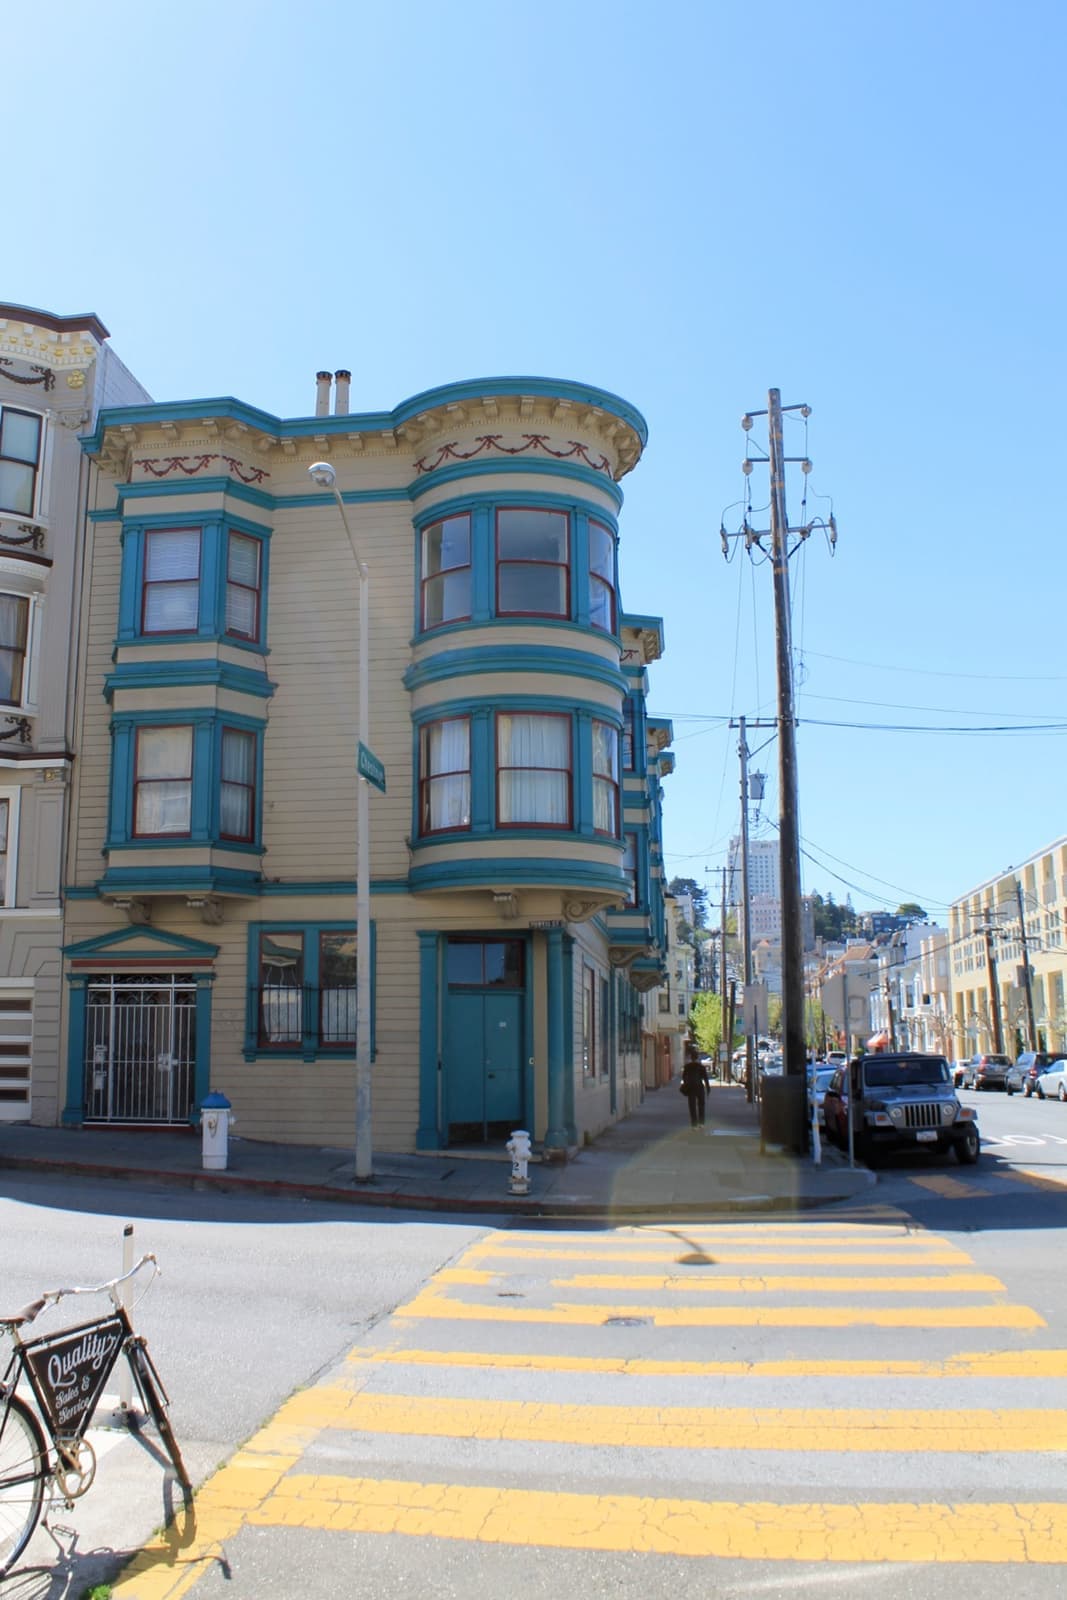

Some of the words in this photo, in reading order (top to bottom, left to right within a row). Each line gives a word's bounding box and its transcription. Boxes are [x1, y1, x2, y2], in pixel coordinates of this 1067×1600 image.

[48, 1333, 118, 1391] Quality
[55, 1387, 80, 1408] Sales
[81, 1375, 91, 1391] &
[58, 1397, 91, 1424] Service
